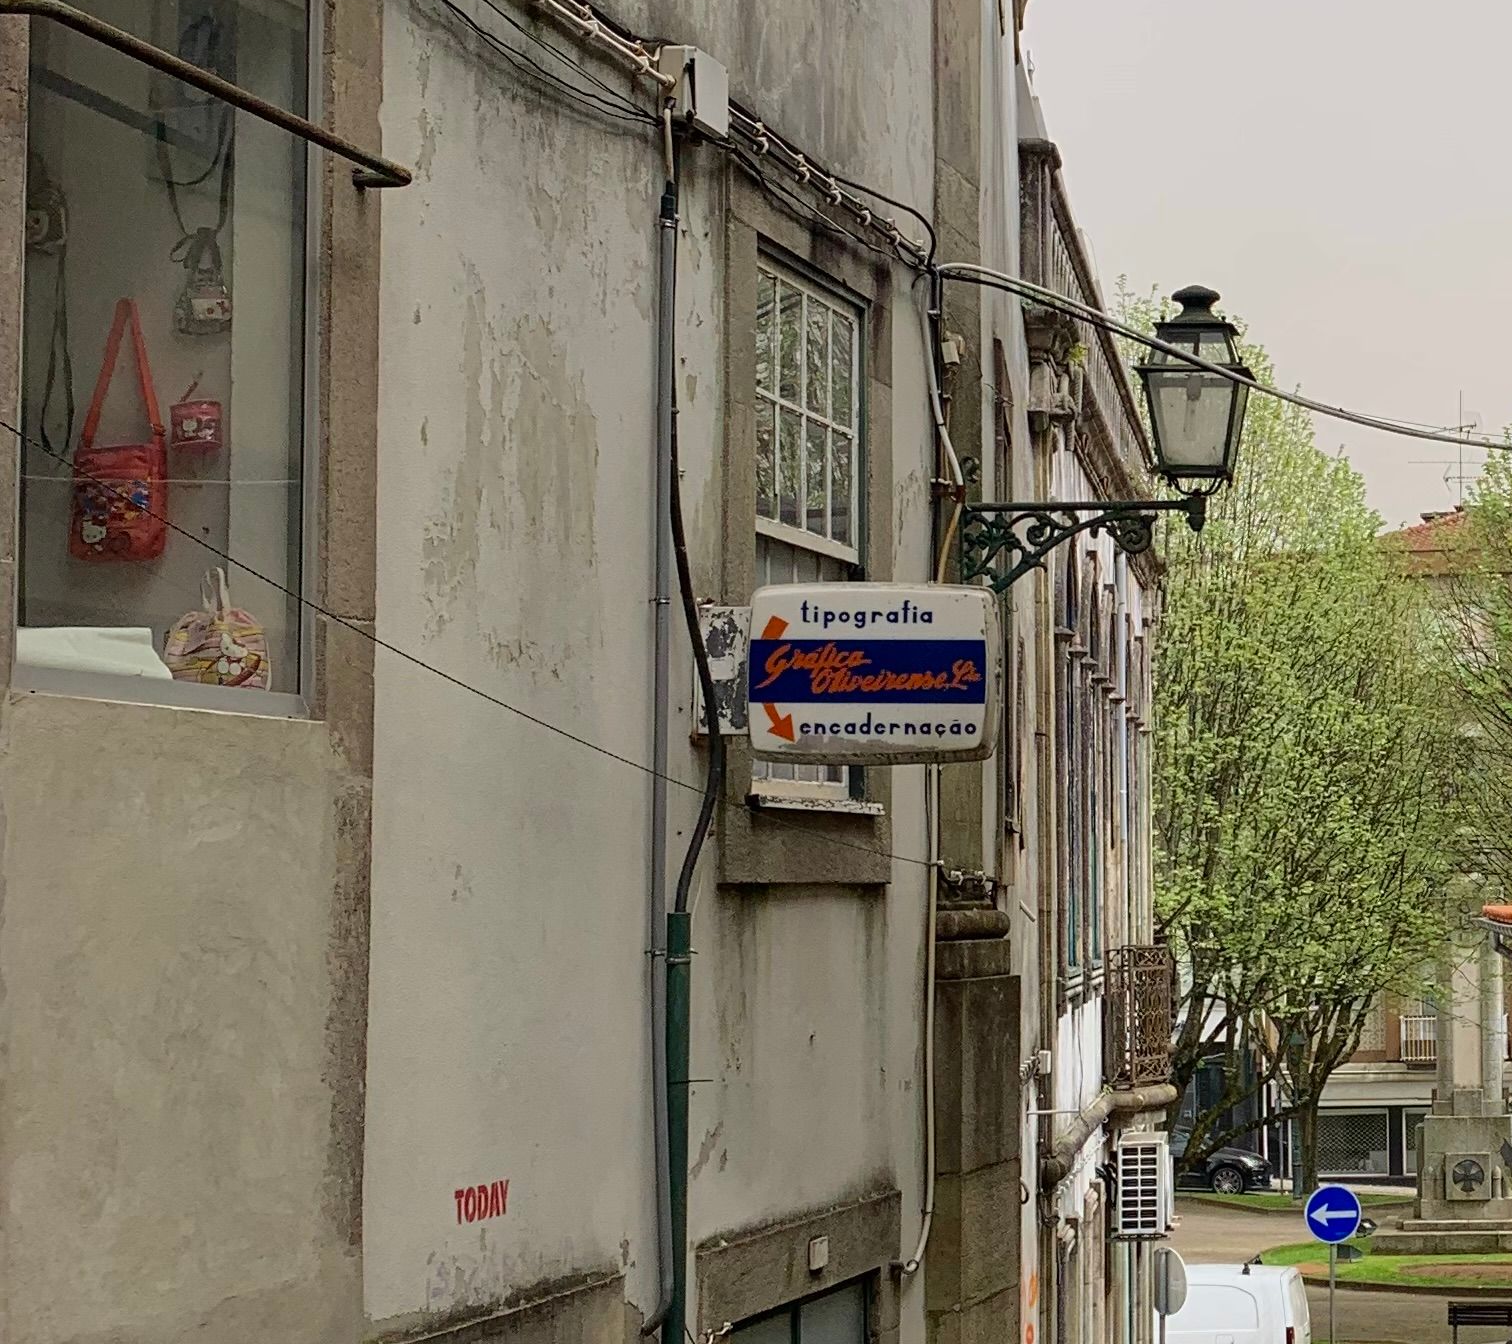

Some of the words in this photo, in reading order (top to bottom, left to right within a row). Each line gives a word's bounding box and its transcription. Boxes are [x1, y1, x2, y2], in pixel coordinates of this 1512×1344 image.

[800, 599, 934, 629] tipografia
[755, 641, 872, 689] Gráfica
[799, 712, 978, 738] encadernação
[454, 1179, 510, 1225] TODAY
